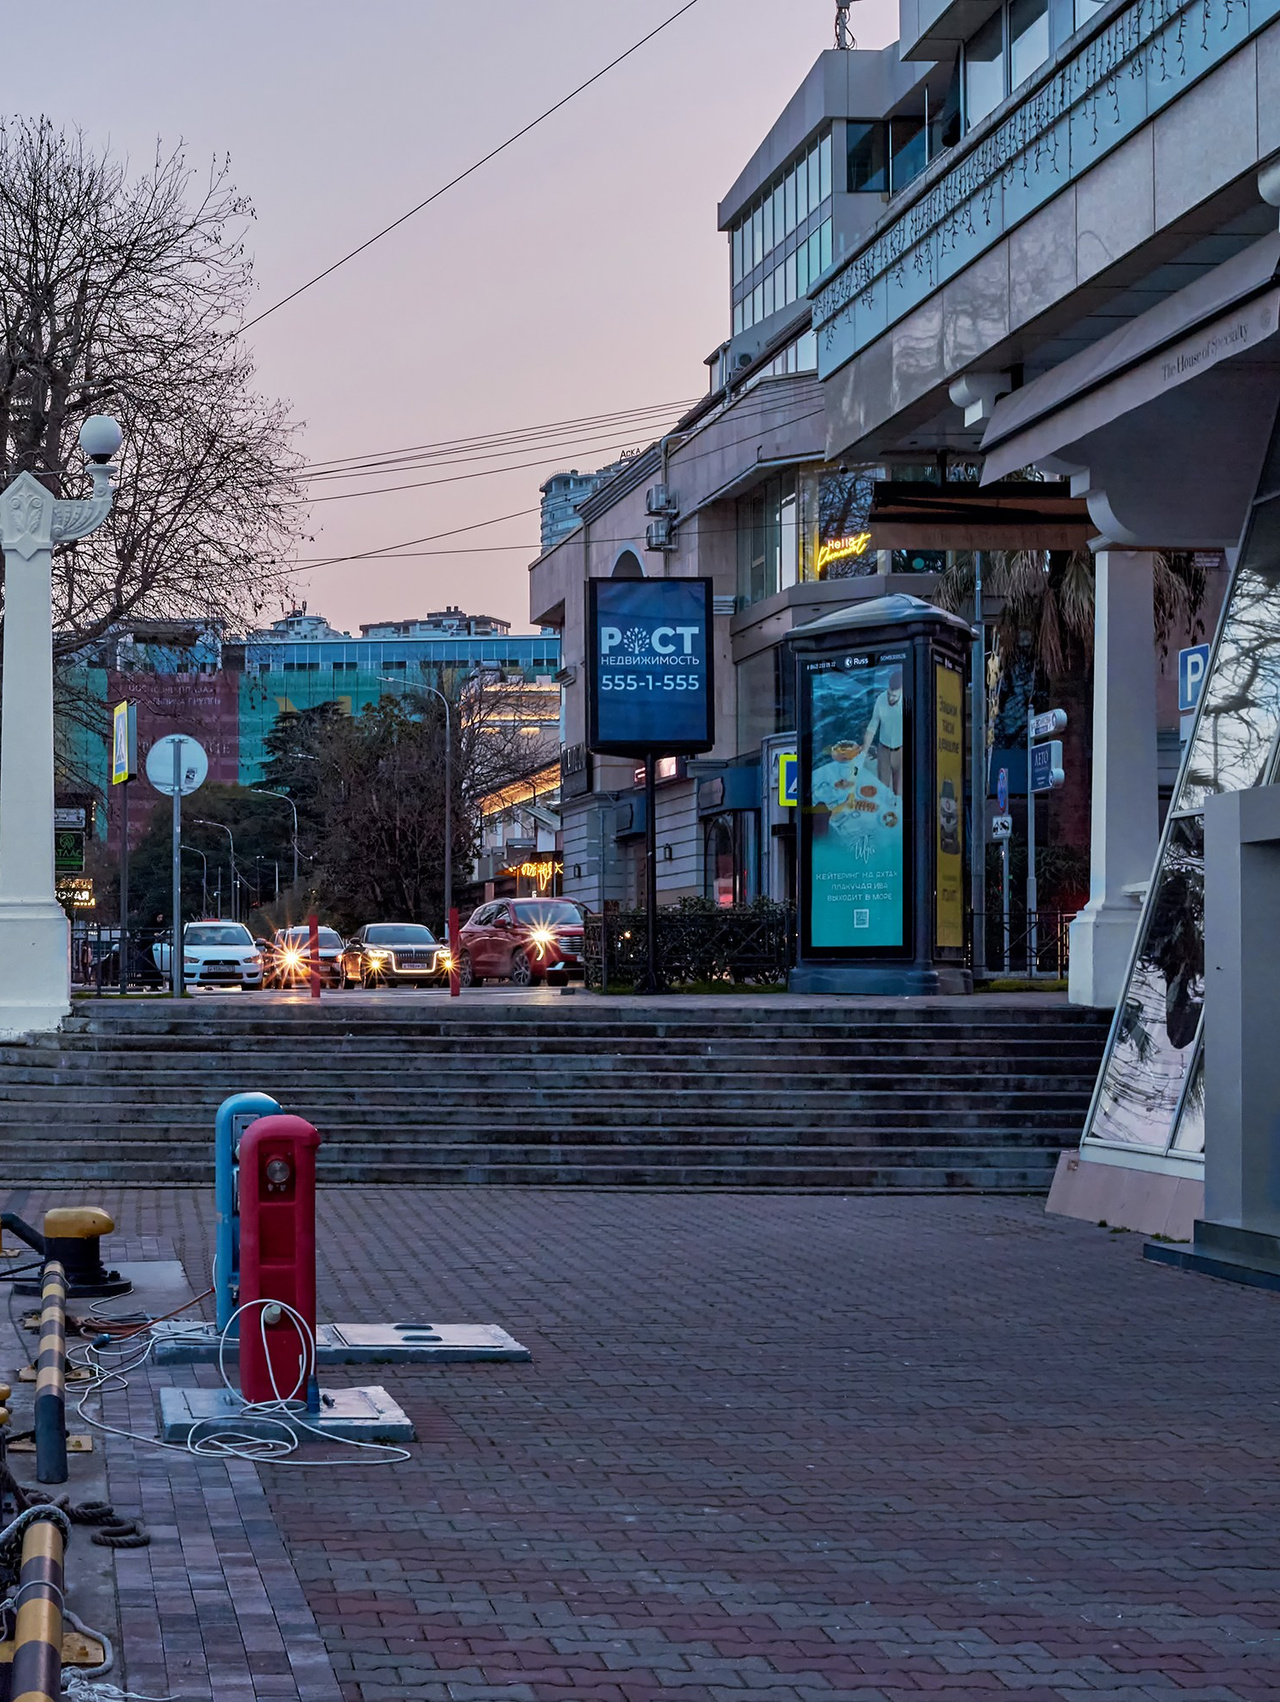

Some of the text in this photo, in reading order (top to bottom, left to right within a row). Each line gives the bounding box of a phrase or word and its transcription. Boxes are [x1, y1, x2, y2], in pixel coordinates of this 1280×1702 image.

[1177, 350, 1201, 374] House
[827, 536, 856, 549] Hello
[601, 656, 700, 665] НЕДВИЖИМОСТЬ
[853, 658, 869, 666] Russ
[601, 675, 700, 691] 555-1-555
[816, 872, 860, 880] КЕЙТЕРИНГ
[827, 894, 863, 902] ВЫХОДИТ
